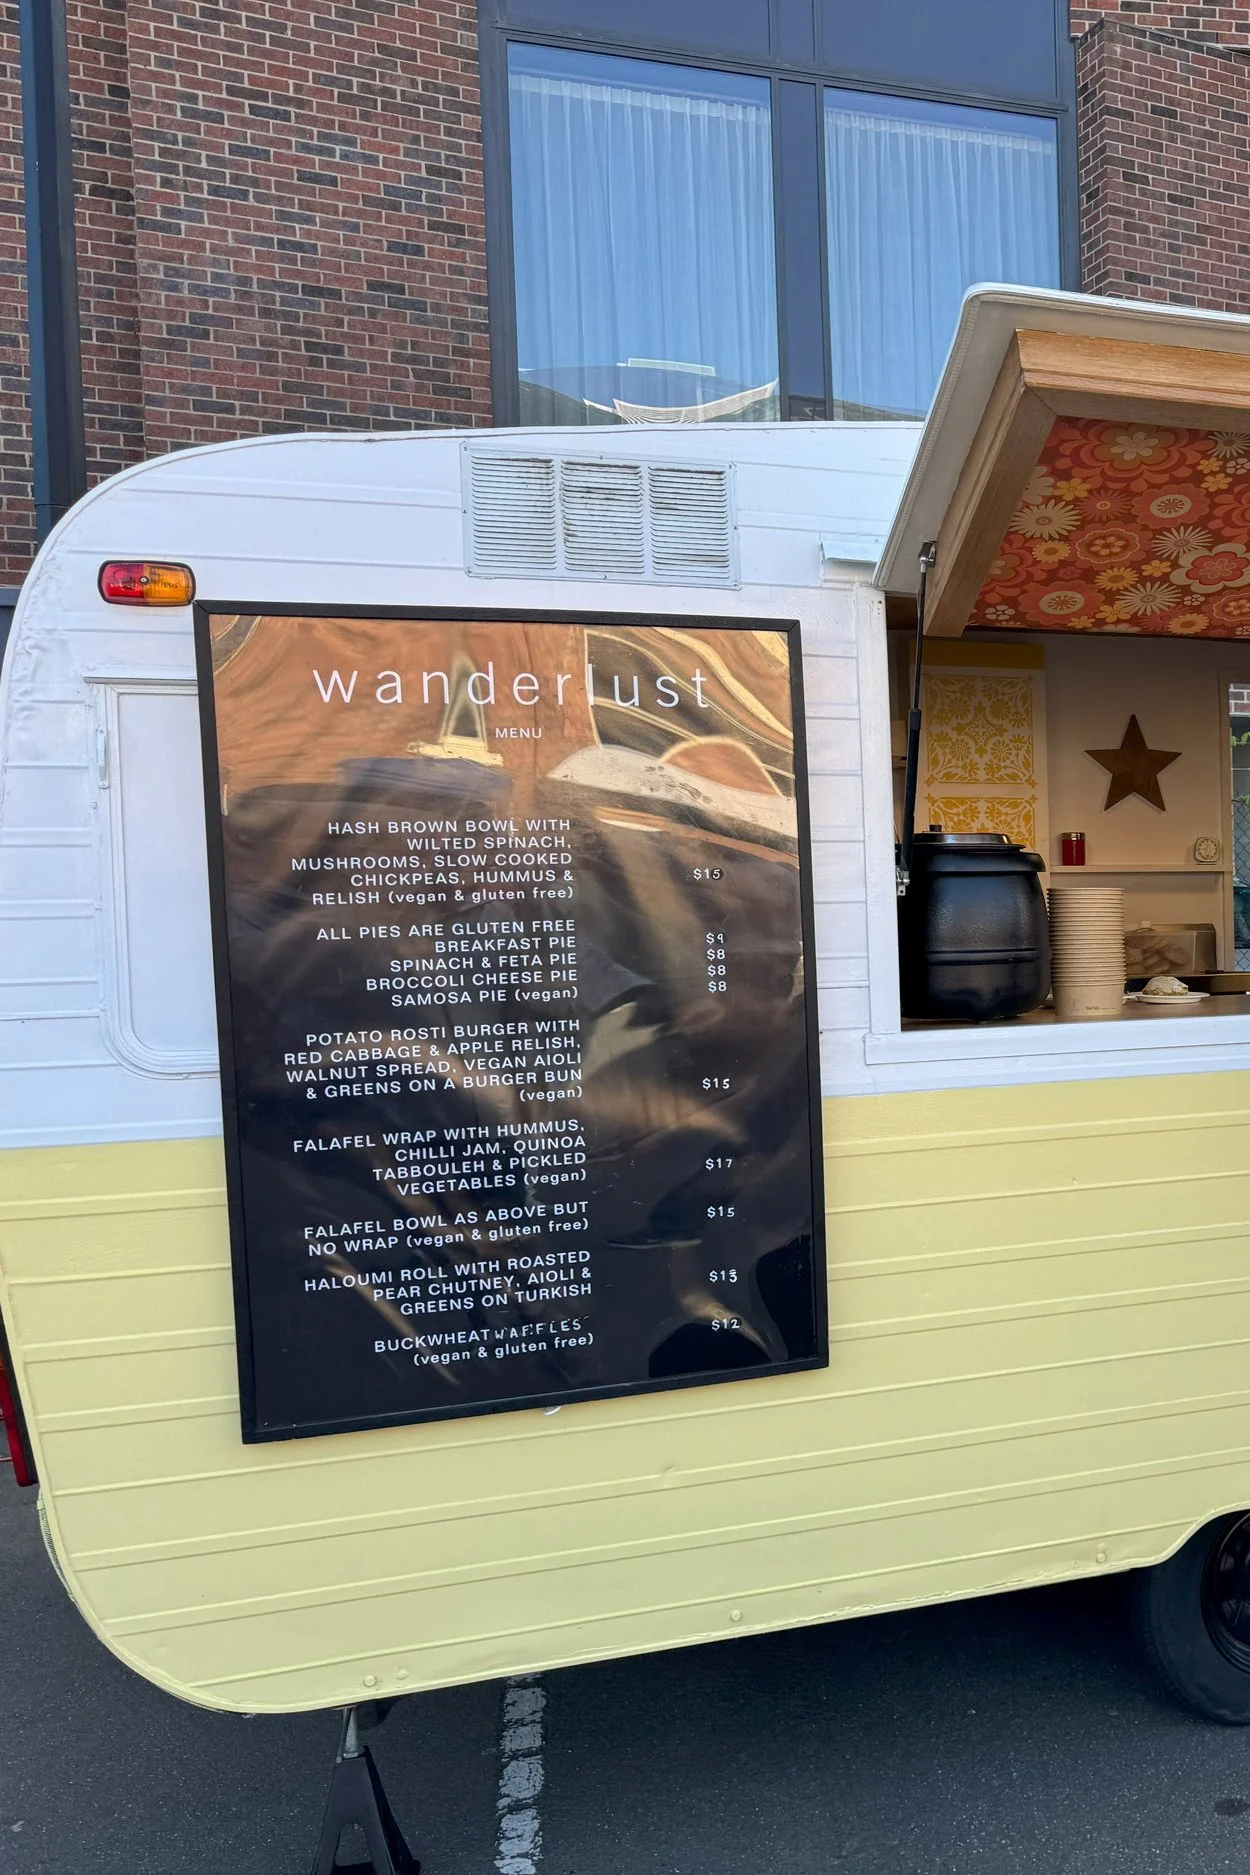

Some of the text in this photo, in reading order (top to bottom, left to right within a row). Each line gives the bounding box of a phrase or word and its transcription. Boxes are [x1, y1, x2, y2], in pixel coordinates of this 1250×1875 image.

[312, 660, 708, 708] wanderlust
[495, 727, 542, 739] MENU
[328, 819, 570, 834] HASH BROWN BOWL WITH
[407, 836, 571, 850] WILTED SPINACH,
[292, 853, 572, 870] MUSHROOMS, SLOW COOKED
[350, 870, 574, 887] CHICKPEAS, HUMMUS &
[693, 868, 720, 880] $15
[312, 887, 574, 905] RELISH (vegan & gluten free)
[316, 920, 575, 940] ALL PIES ARE GLUTEN FREE
[435, 937, 576, 952] BREAKFAST PIE
[707, 948, 725, 961] $8
[390, 953, 576, 972] SPINACH & FETA PIE
[707, 964, 726, 977] $8
[366, 970, 577, 991] BROCCOLI CHEESE PIE
[708, 980, 726, 993] $8
[391, 986, 578, 1007] SAMOSA PIE (vegan)
[306, 1019, 580, 1046] POTATO ROSTI BURGER WITH
[284, 1036, 580, 1065] RED CABBAGE & APPLE RELISH,
[286, 1053, 581, 1083] WALNUT SPREAD, VEGAN AIOLI
[306, 1069, 582, 1100] & GREENS ON A BURGER BUN
[702, 1077, 730, 1090] $15
[519, 1086, 582, 1102] (vegan)
[294, 1119, 584, 1152] FALAFEL WRAP WITH HUMMUS,
[395, 1136, 586, 1162] CHILLI JAM, QUINOA
[372, 1152, 586, 1181] TABBOULEH & PICKLED
[705, 1158, 732, 1171] $17
[398, 1169, 586, 1196] VEGETABLES (vegan)
[304, 1202, 588, 1239] FALAFEL BOWL AS ABOVE BUT
[707, 1206, 735, 1219] $15
[309, 1218, 589, 1256] NO WRAP (vegan & gluten free)
[304, 1250, 590, 1292] HALOUMI ROLL WITH ROASTED
[374, 1267, 592, 1302] PEAR CHUTNEY, AIOLI &
[400, 1284, 592, 1315] GREENS ON TURKISH
[711, 1319, 740, 1332] $12
[374, 1329, 490, 1352] BUCKWHEAT
[414, 1333, 594, 1366] (vegan & gluten free)
